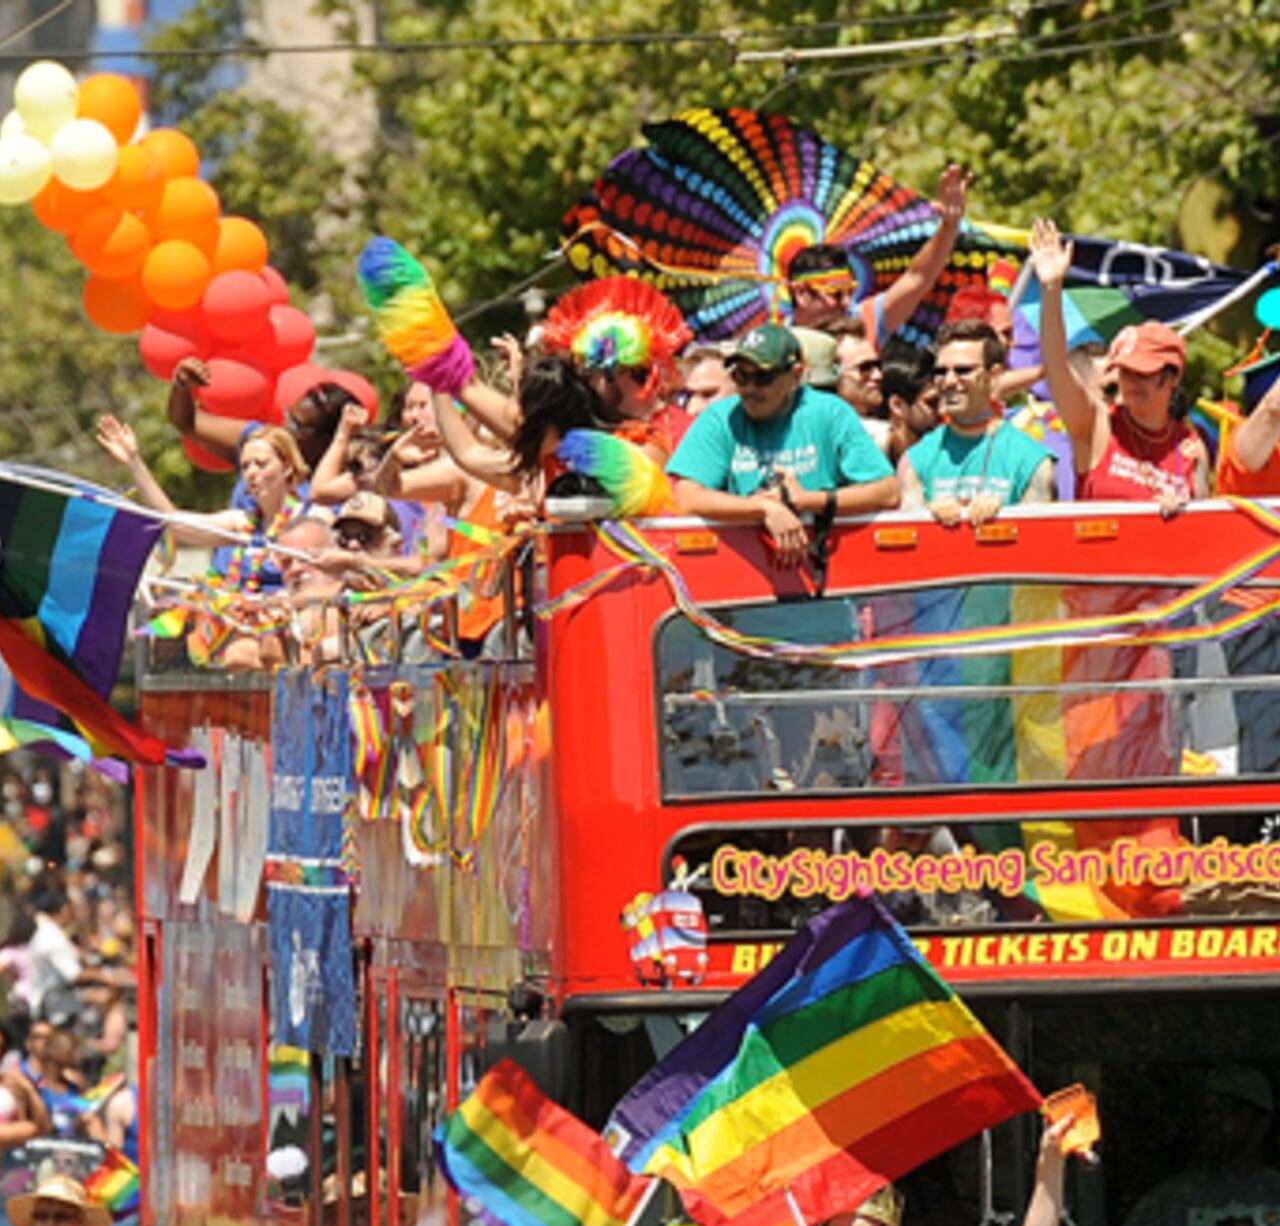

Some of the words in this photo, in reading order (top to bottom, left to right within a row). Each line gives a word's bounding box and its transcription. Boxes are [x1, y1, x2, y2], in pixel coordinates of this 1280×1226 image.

[712, 844, 1025, 901] CitySightseeing
[1033, 841, 1104, 888] San
[941, 932, 1090, 967] TICKETS
[1102, 930, 1161, 961] ON
